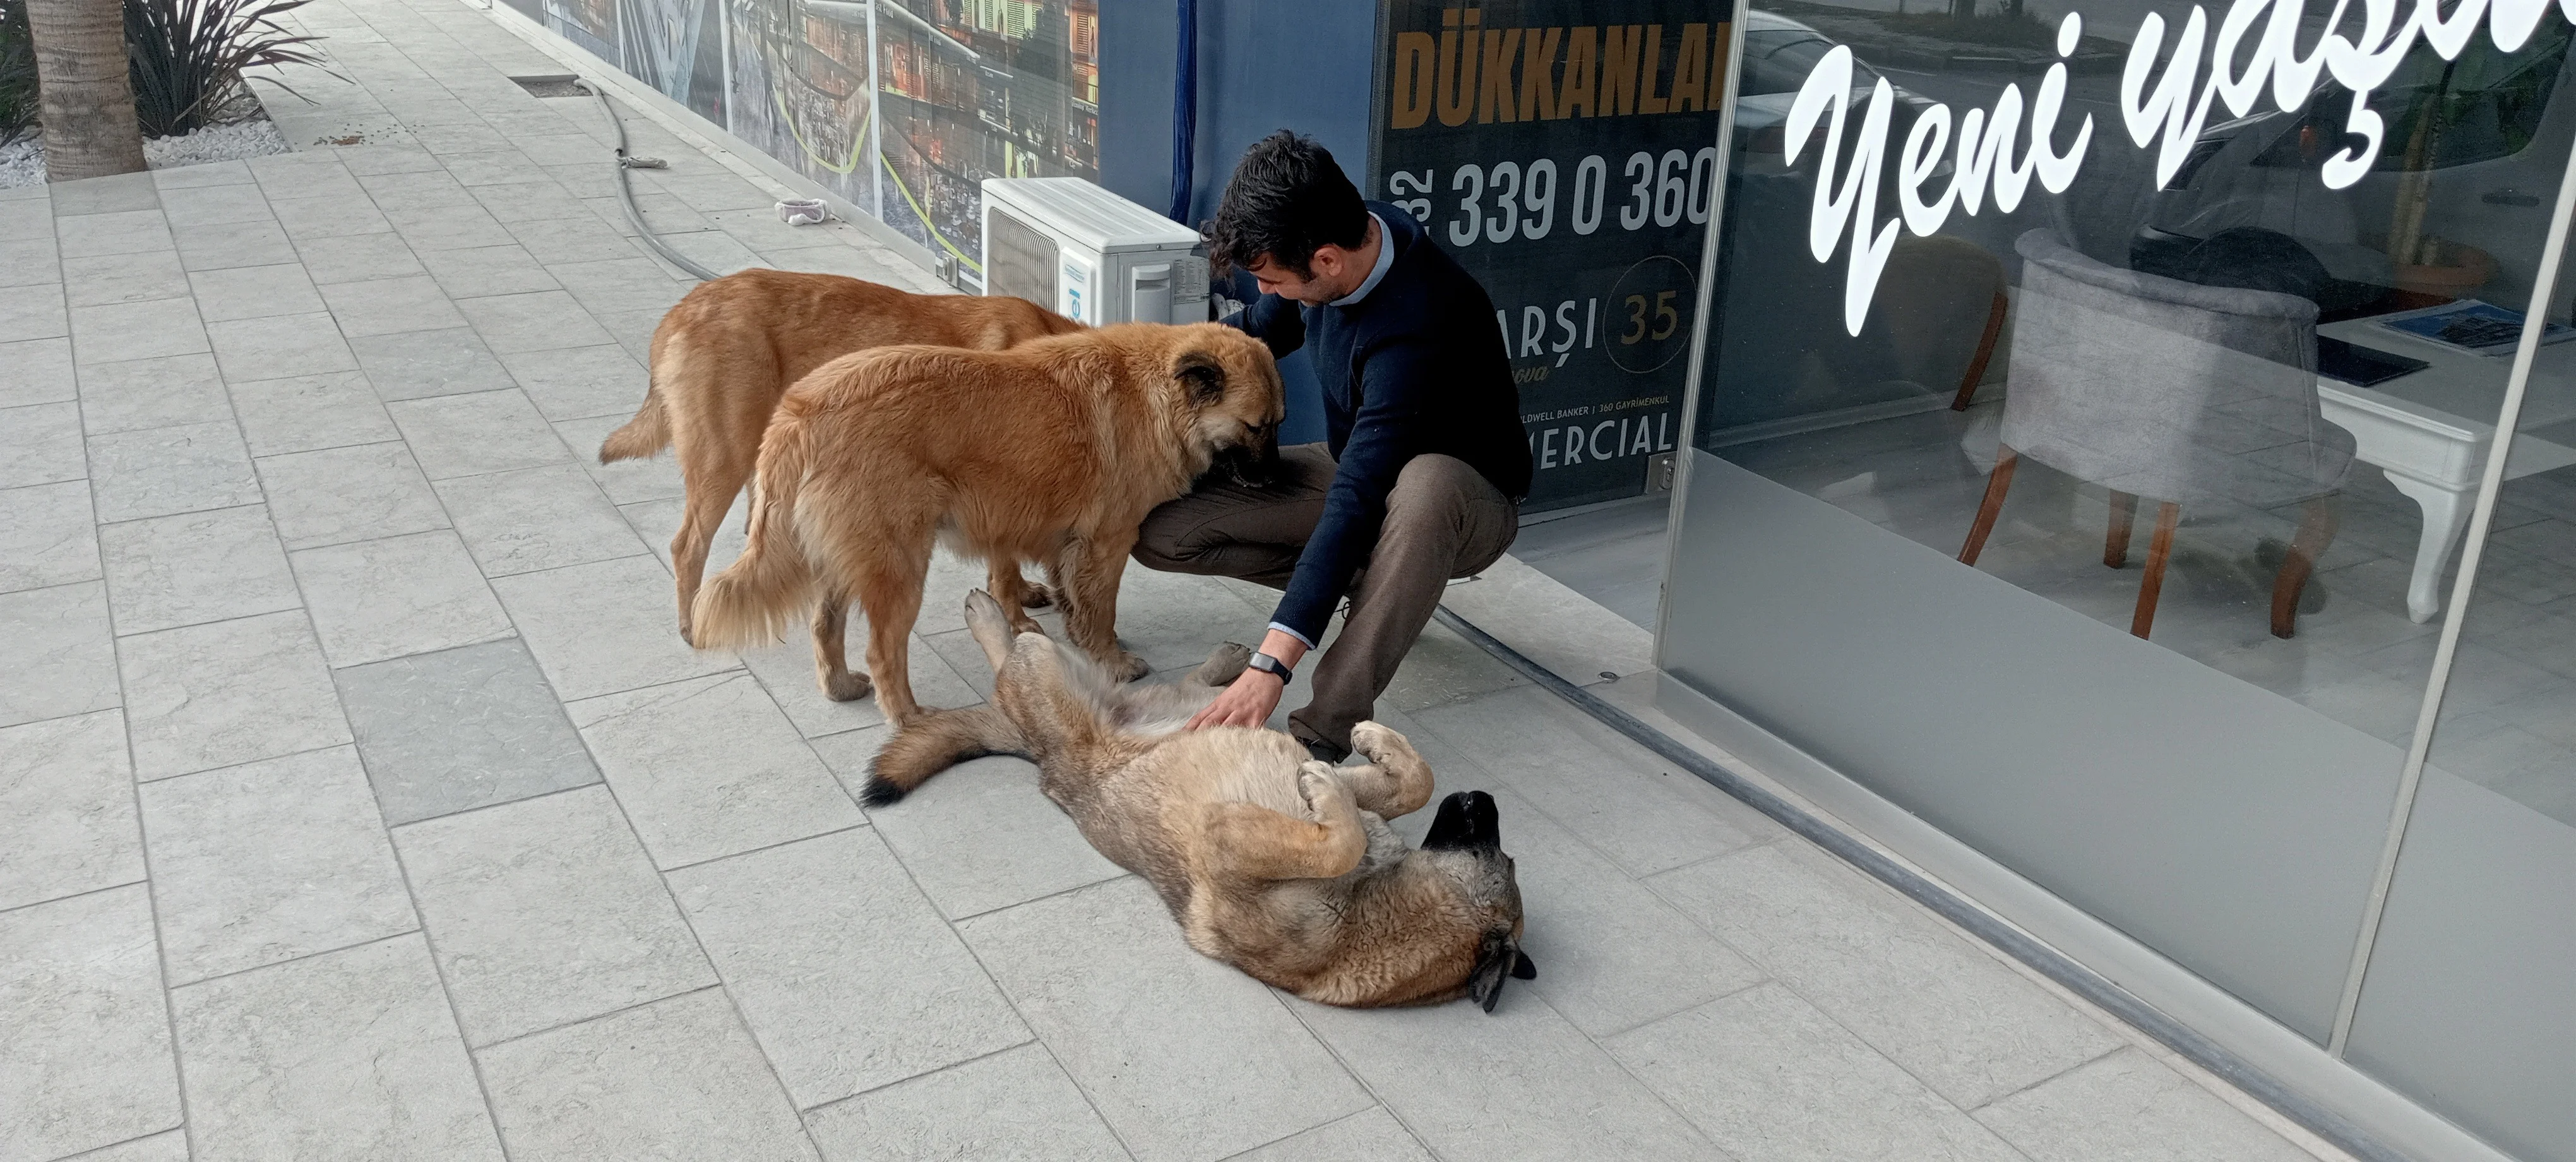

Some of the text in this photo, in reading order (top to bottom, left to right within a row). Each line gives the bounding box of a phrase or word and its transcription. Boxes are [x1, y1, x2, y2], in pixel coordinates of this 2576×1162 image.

[1390, 147, 1716, 247] 32 339 0 360
[1785, 11, 2094, 337] Yeni
[1621, 290, 1679, 345] 35
[1513, 366, 1549, 385] ova
[1557, 406, 1589, 419] BANKER
[1599, 404, 1614, 413] 360
[1616, 395, 1670, 410] GAYRİMENKUL
